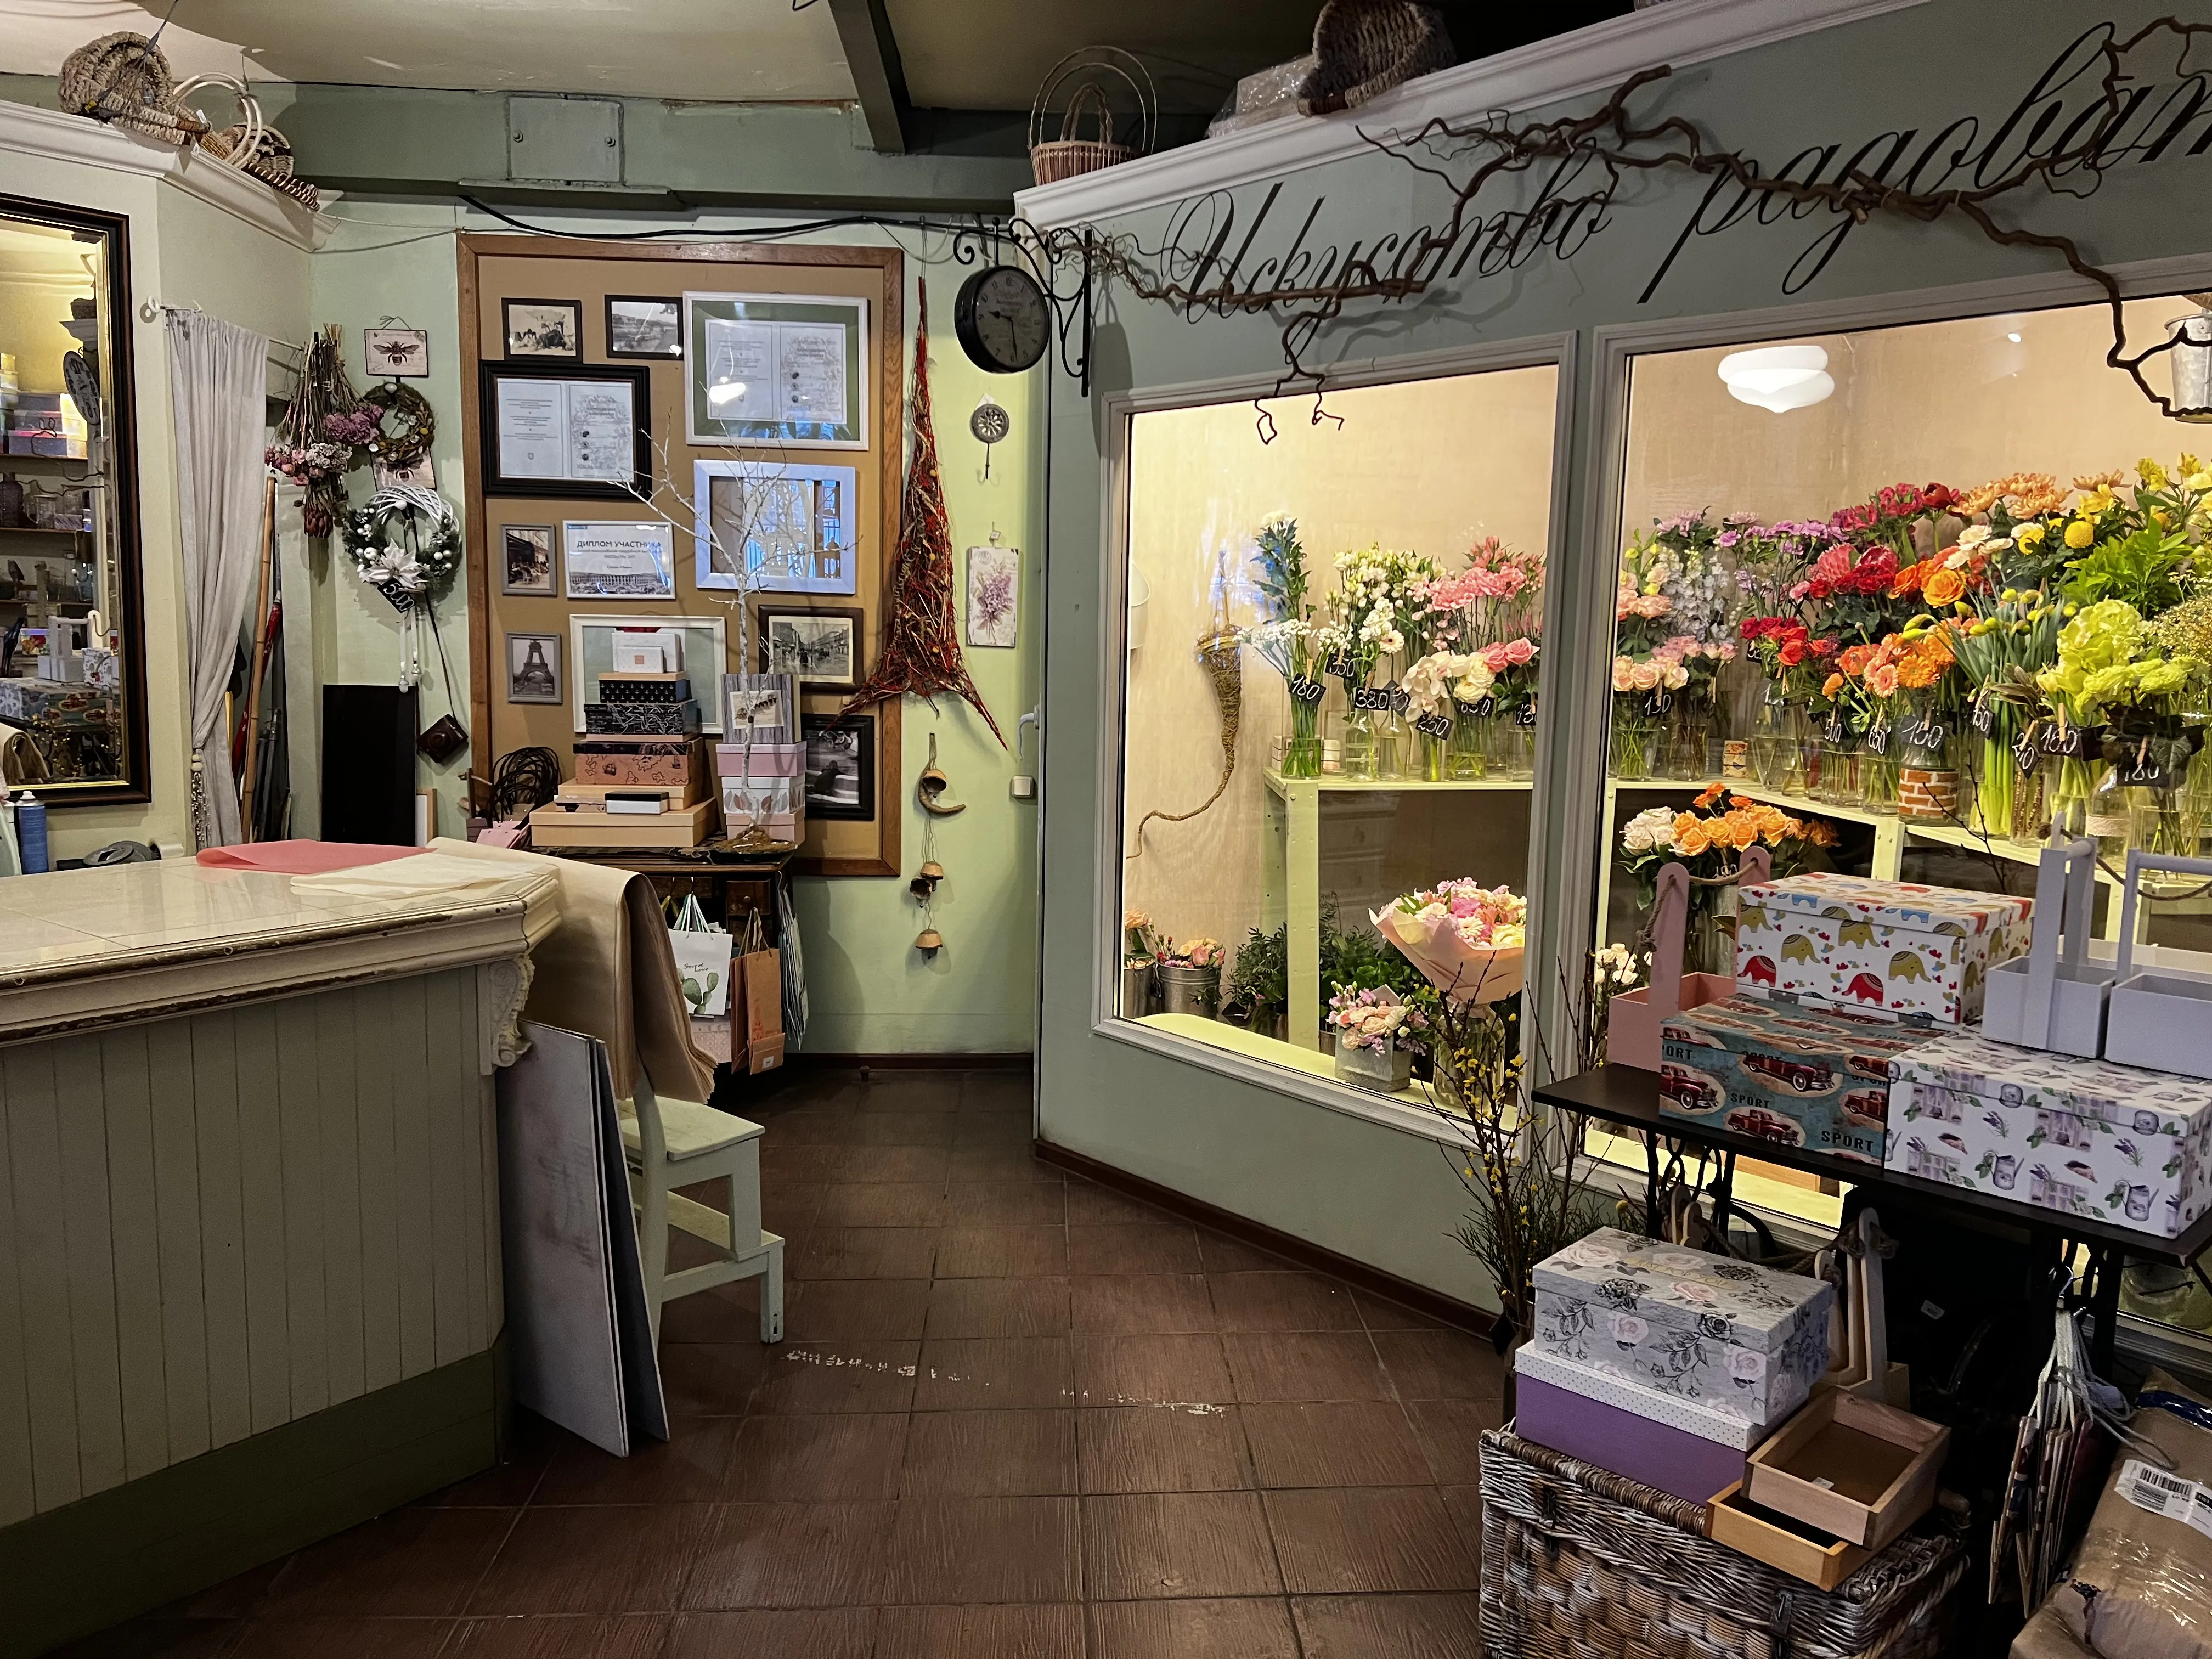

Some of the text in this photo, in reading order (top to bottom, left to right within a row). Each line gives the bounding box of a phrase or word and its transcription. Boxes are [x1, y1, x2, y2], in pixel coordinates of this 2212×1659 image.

[1291, 675, 1320, 700] 180
[1517, 703, 1537, 724] 13
[1418, 716, 1449, 736] 250
[1901, 720, 1944, 749] 150
[1662, 1044, 1692, 1060] ORT
[1730, 1092, 1770, 1109] SPORT
[1821, 1130, 1874, 1152] SPORT
